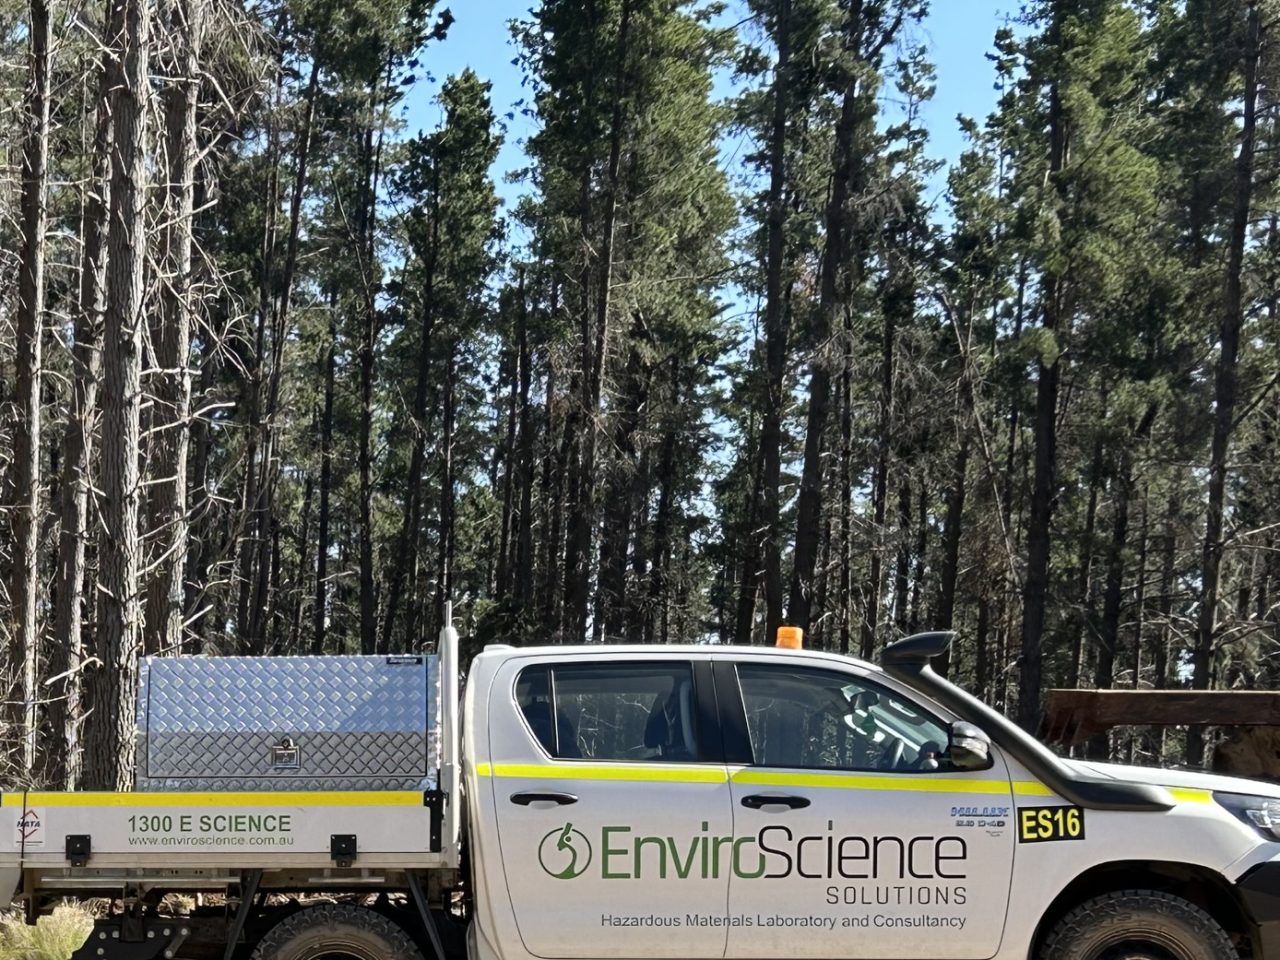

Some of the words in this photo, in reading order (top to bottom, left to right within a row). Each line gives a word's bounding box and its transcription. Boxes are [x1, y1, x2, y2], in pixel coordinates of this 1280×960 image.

[128, 815, 173, 832] 1300
[180, 815, 192, 832] E
[199, 815, 291, 832] SCIENCE
[1021, 808, 1081, 839] ES16
[128, 835, 294, 846] www.enviroscience.com.au
[601, 820, 967, 879] EnviroScience
[826, 886, 967, 905] SOLUTIONS
[601, 914, 681, 927] Hazardous
[686, 914, 753, 927] Materials
[757, 914, 837, 930] Laboratory
[841, 914, 870, 927] and
[873, 914, 967, 930] Consultancy
